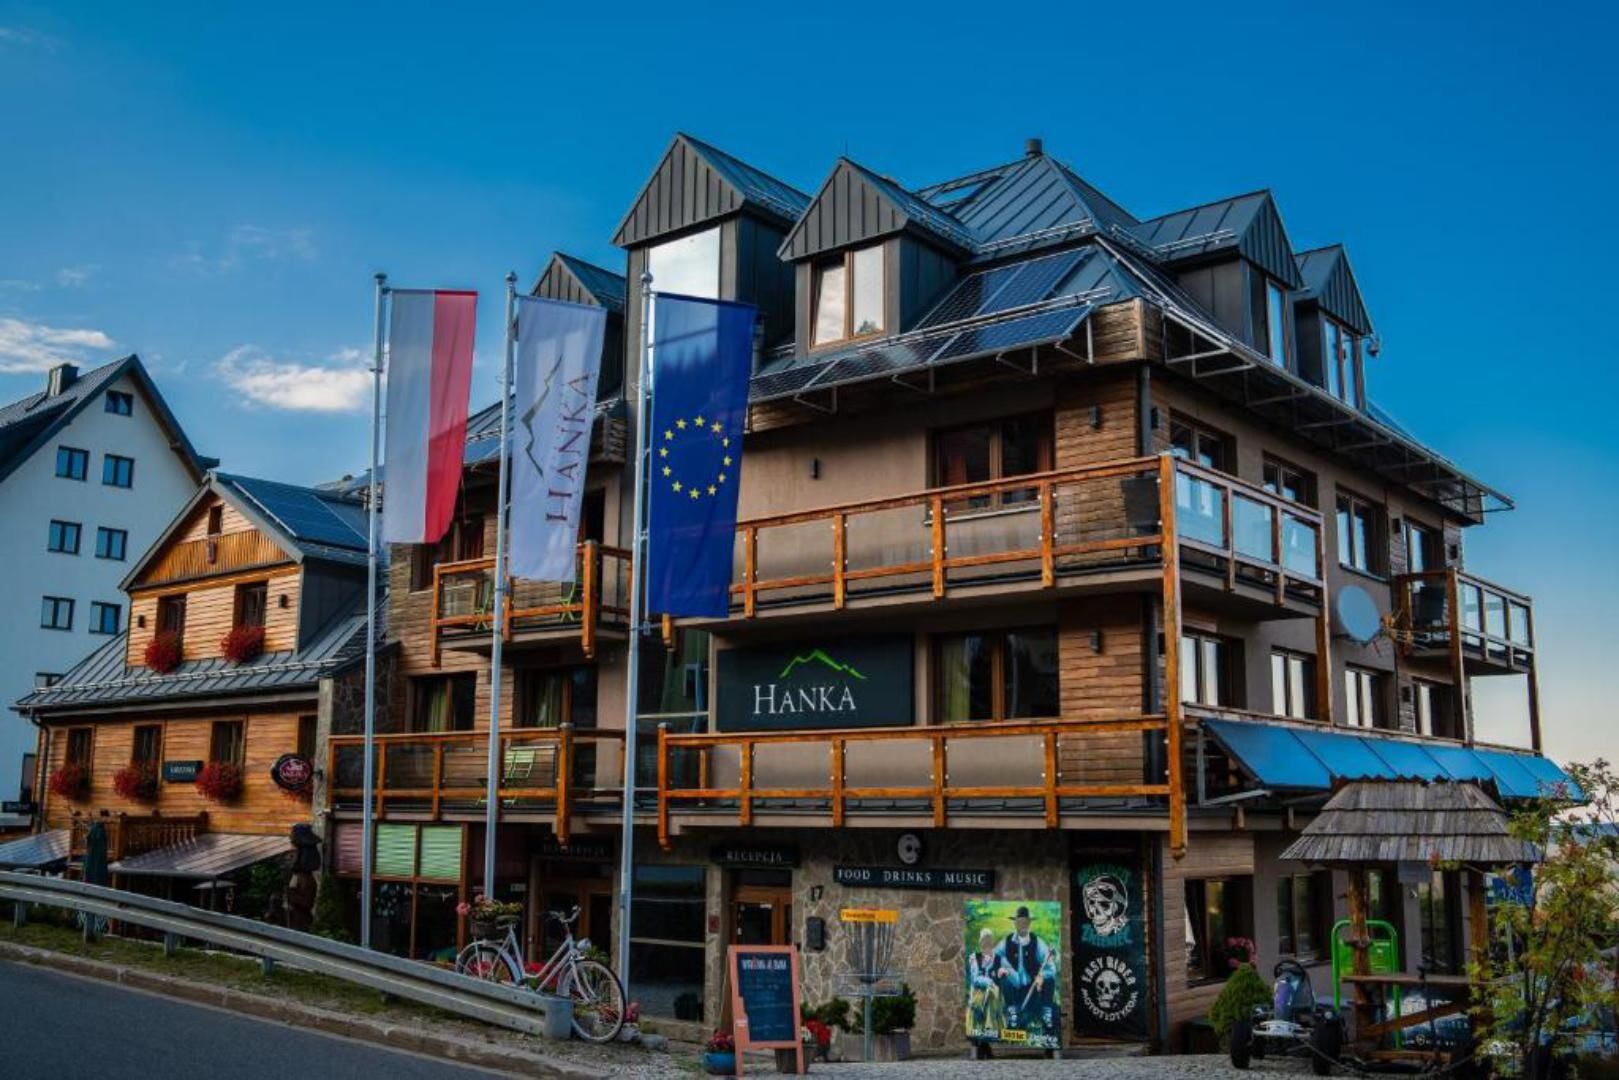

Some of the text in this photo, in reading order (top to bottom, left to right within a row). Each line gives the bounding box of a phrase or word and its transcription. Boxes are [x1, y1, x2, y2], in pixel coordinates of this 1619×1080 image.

[545, 371, 590, 524] HANKA
[753, 683, 857, 715] HANKA
[726, 849, 783, 864] RECEPCJA
[838, 869, 986, 885] FOOD DRINKS MUSIC
[810, 885, 824, 902] 17
[1080, 955, 1137, 986] EASY RIDER
